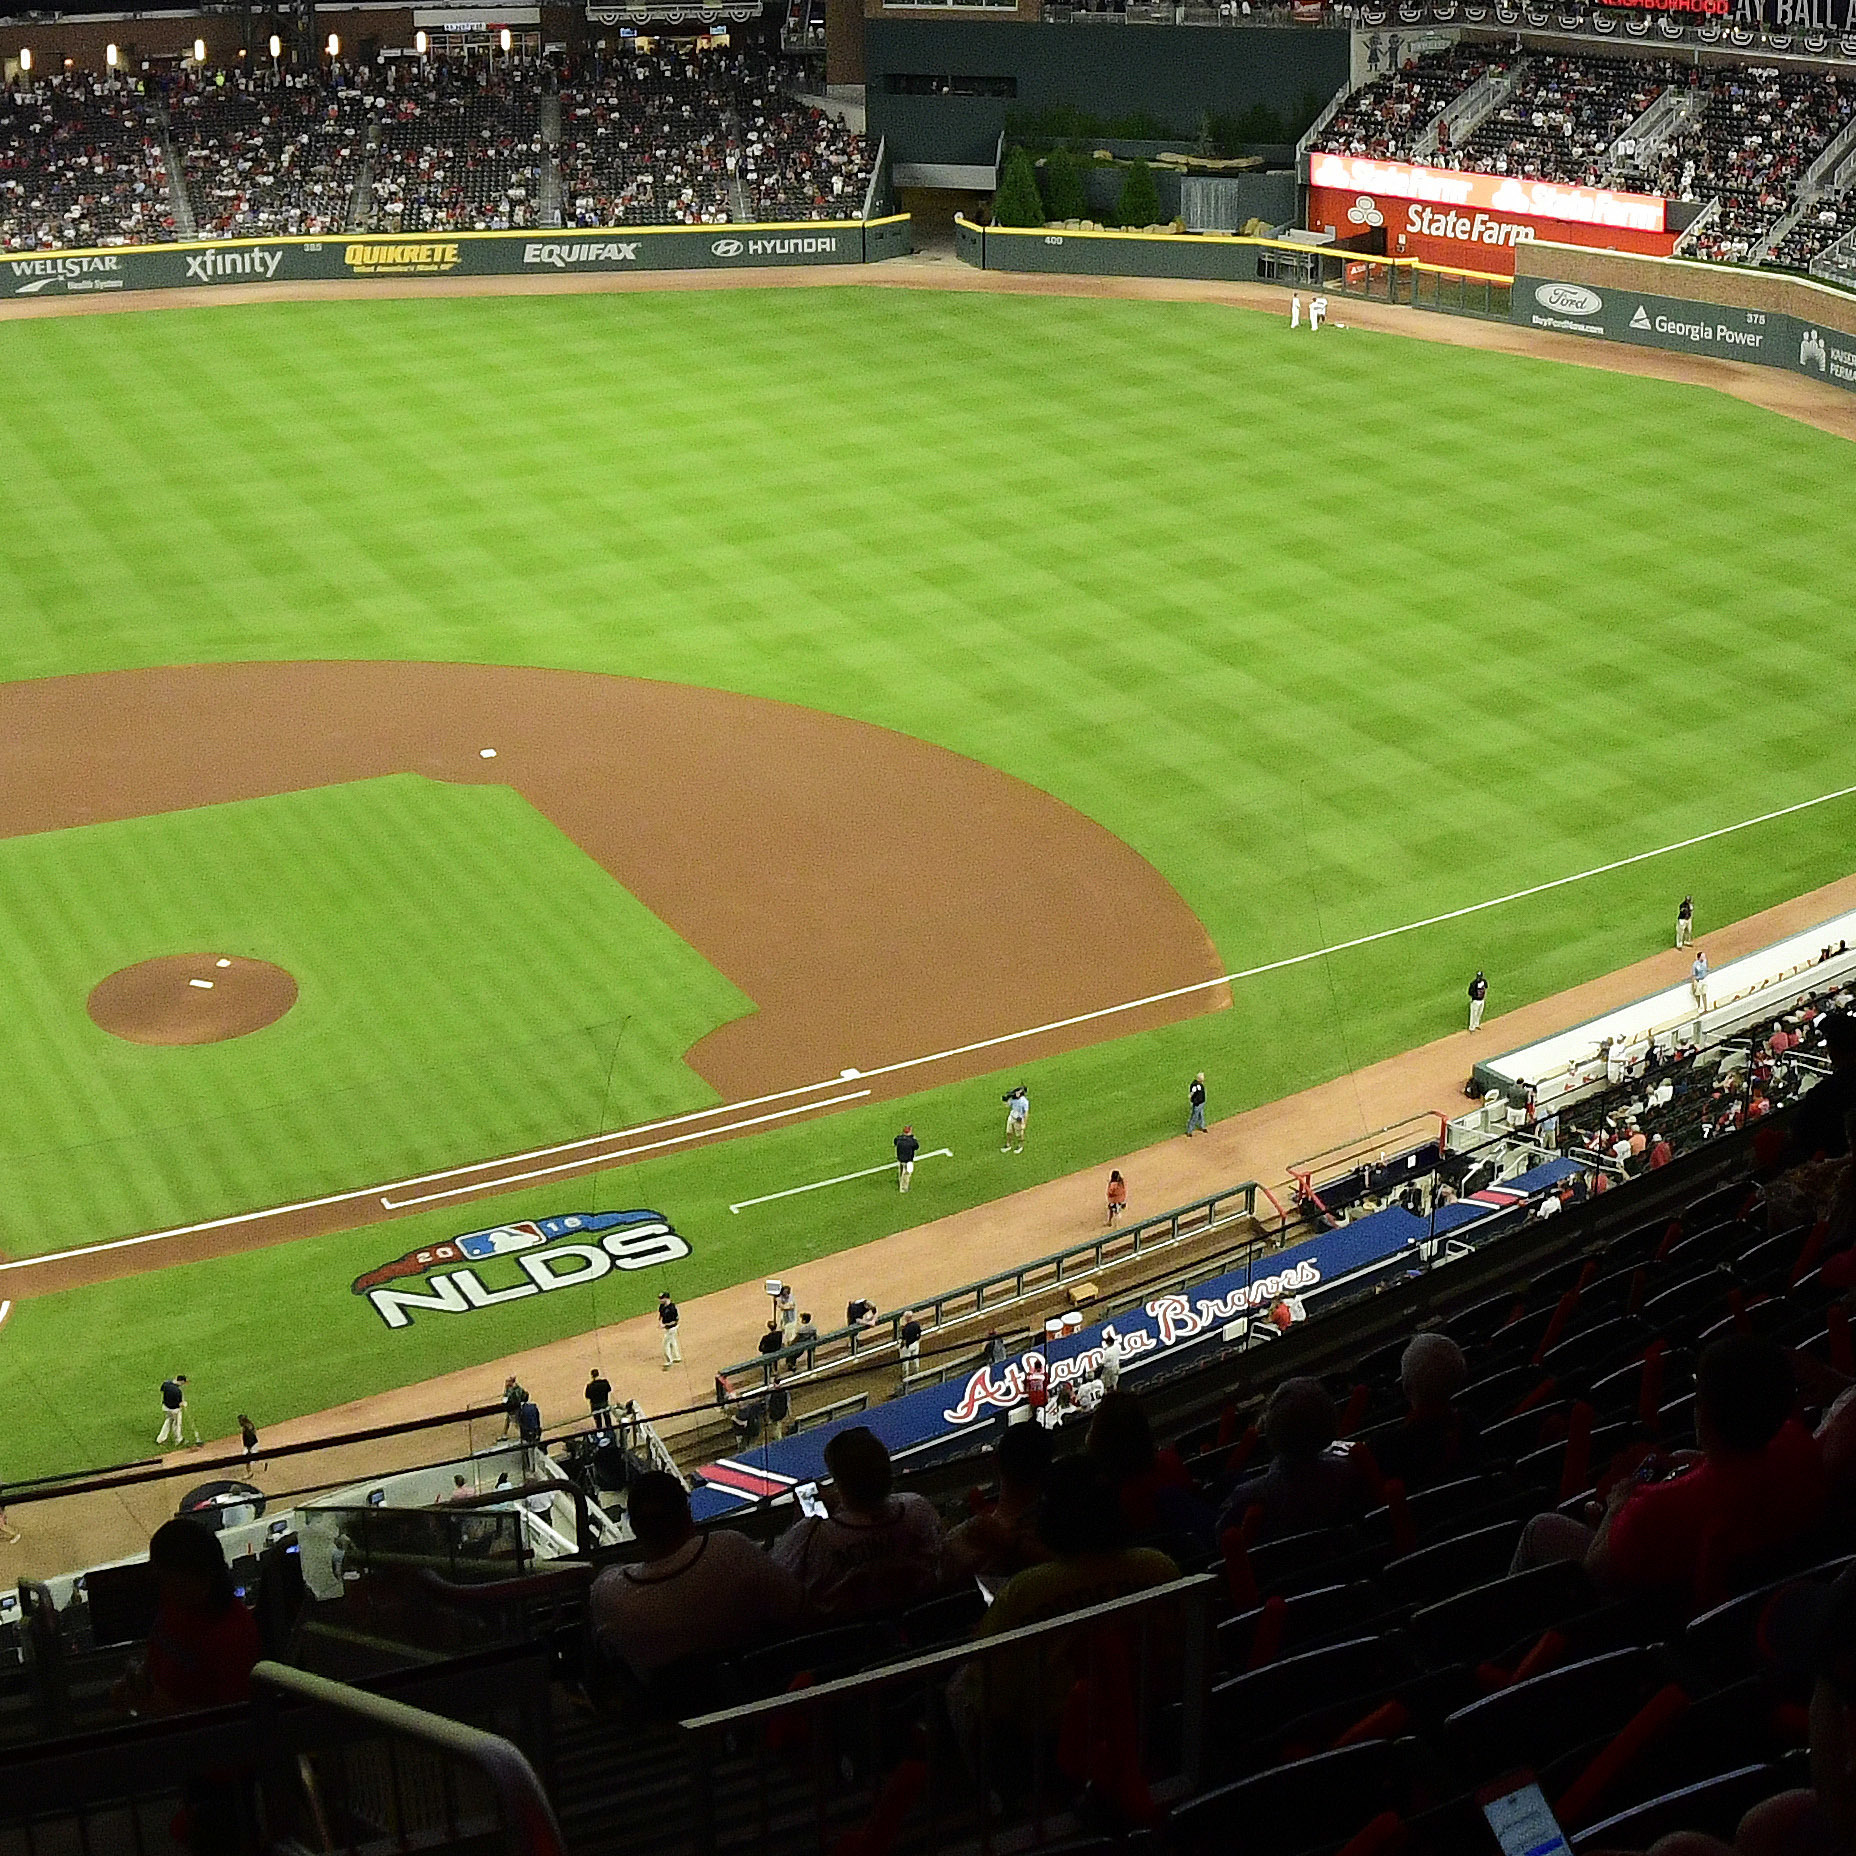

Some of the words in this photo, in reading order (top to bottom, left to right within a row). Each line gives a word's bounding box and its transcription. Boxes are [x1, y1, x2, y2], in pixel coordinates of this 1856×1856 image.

[748, 237, 836, 254] HYUNDAI
[1044, 236, 1064, 246] 400
[11, 256, 119, 277] WELLSTAR
[185, 246, 283, 282] xfinity
[345, 243, 460, 268] QUIKRETE
[523, 243, 639, 268] EQUIFAX
[1548, 288, 1588, 310] Ford
[1656, 316, 1712, 340] Georgia
[1716, 328, 1762, 347] Power
[416, 1247, 454, 1264] 20
[370, 1222, 690, 1329] NLDS
[1146, 1258, 1321, 1345] Braves
